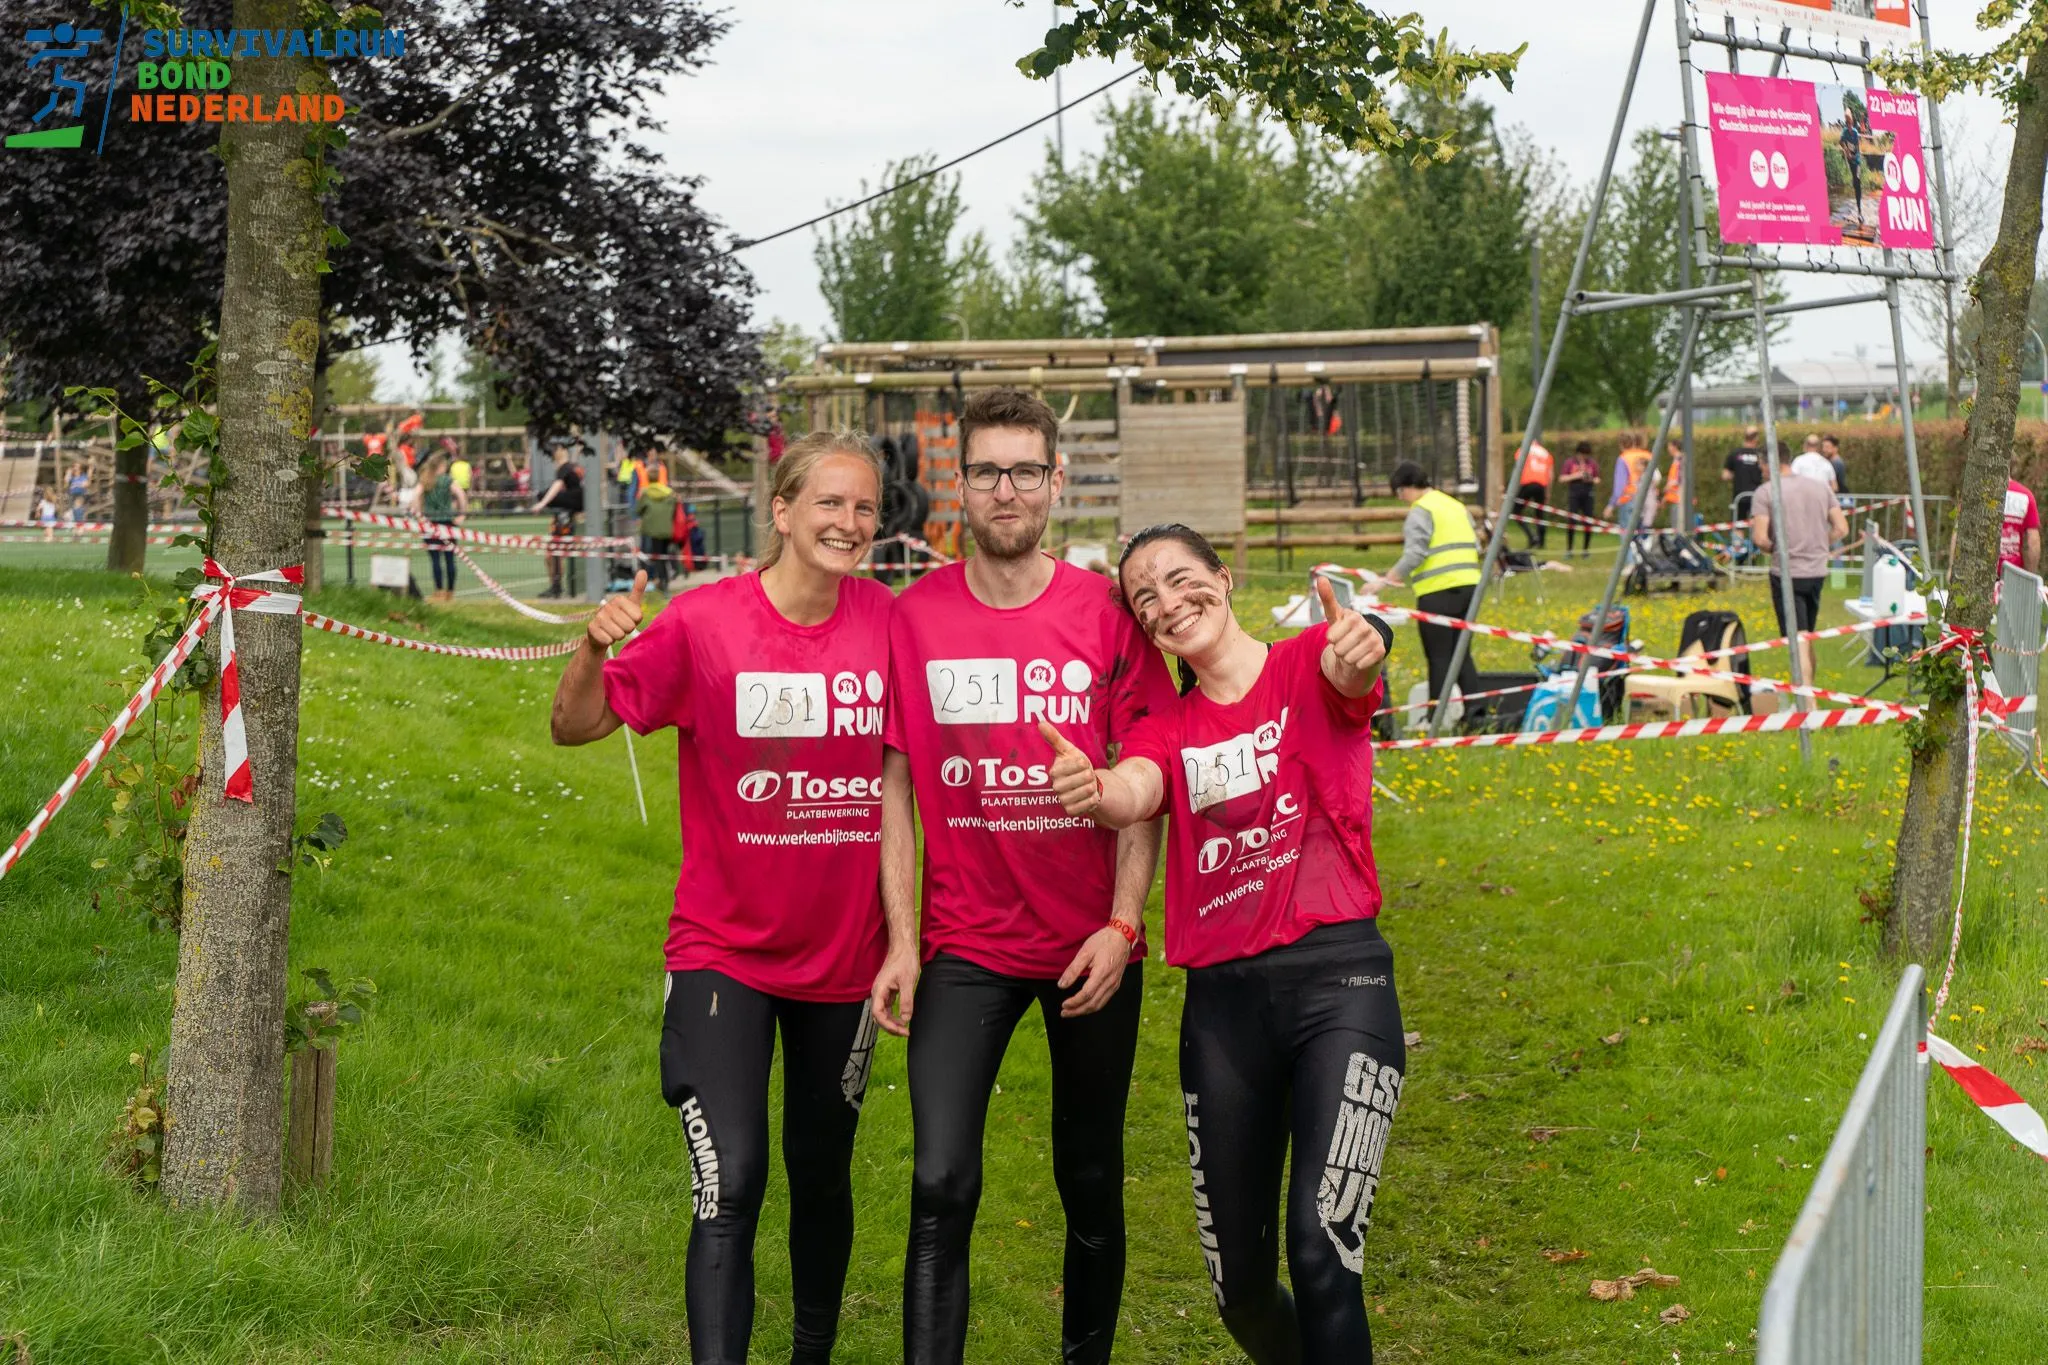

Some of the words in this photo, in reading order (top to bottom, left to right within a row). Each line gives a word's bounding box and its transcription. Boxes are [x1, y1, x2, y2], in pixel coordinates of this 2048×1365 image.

[1869, 95, 1881, 113] 22
[1881, 97, 1896, 117] juni
[1896, 98, 1917, 117] 2024
[1886, 195, 1928, 232] RUN
[749, 683, 815, 730] 251
[940, 668, 1004, 713] 251
[833, 707, 883, 737] RUN
[1024, 695, 1090, 724] RUN
[977, 758, 1049, 787] Tos
[1185, 748, 1250, 797] 251
[786, 808, 869, 820] PLAATBEWERKING
[681, 1096, 720, 1221] HOMMES
